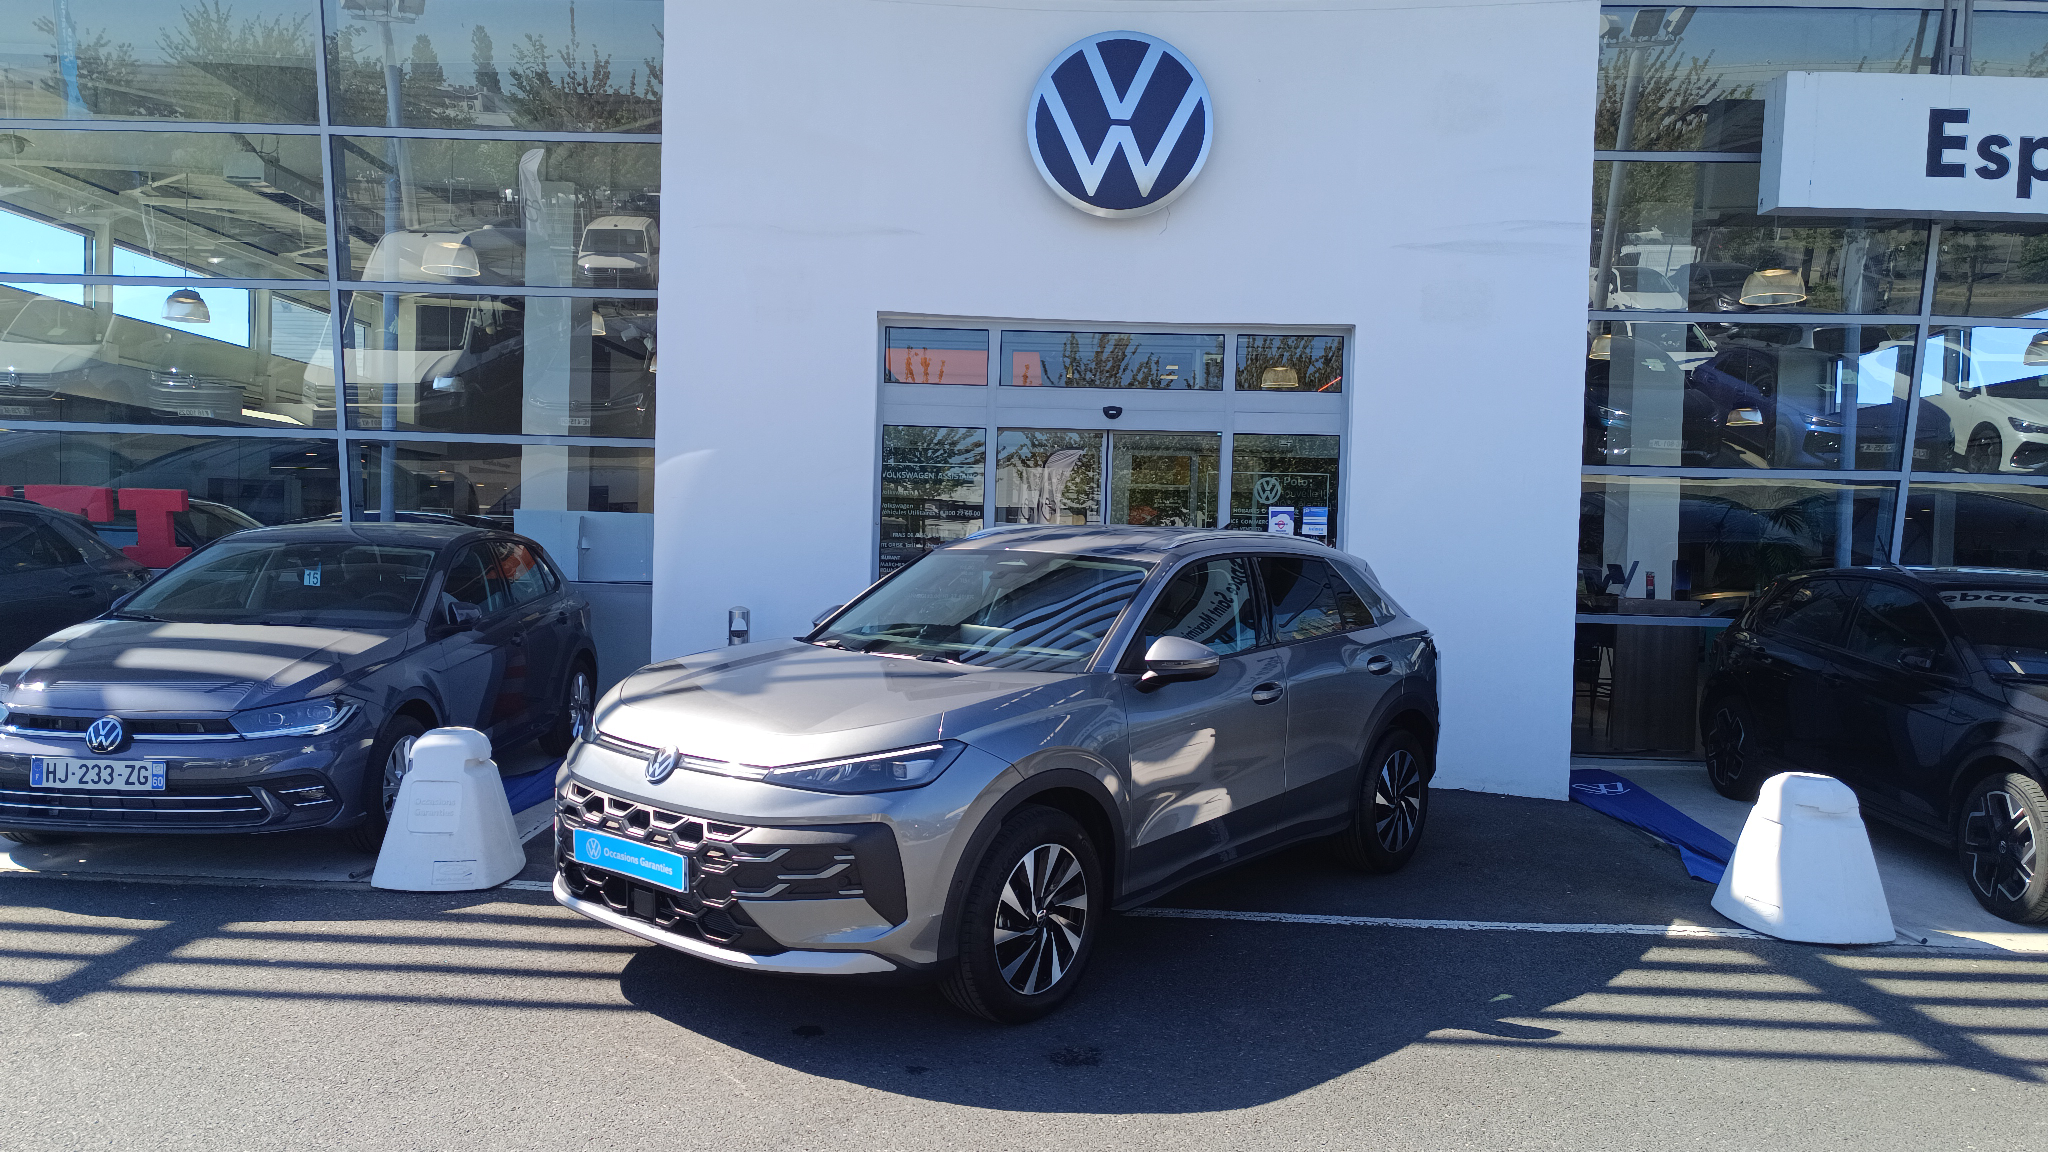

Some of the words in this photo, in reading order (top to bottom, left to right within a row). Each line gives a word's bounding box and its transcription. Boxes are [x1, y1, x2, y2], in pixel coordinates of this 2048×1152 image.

[1926, 107, 2048, 199] Esp
[307, 571, 319, 585] 15
[45, 762, 149, 785] HJ-233-ZG
[152, 776, 163, 786] 60
[603, 847, 639, 865] Occasions
[639, 857, 673, 875] Garanties
